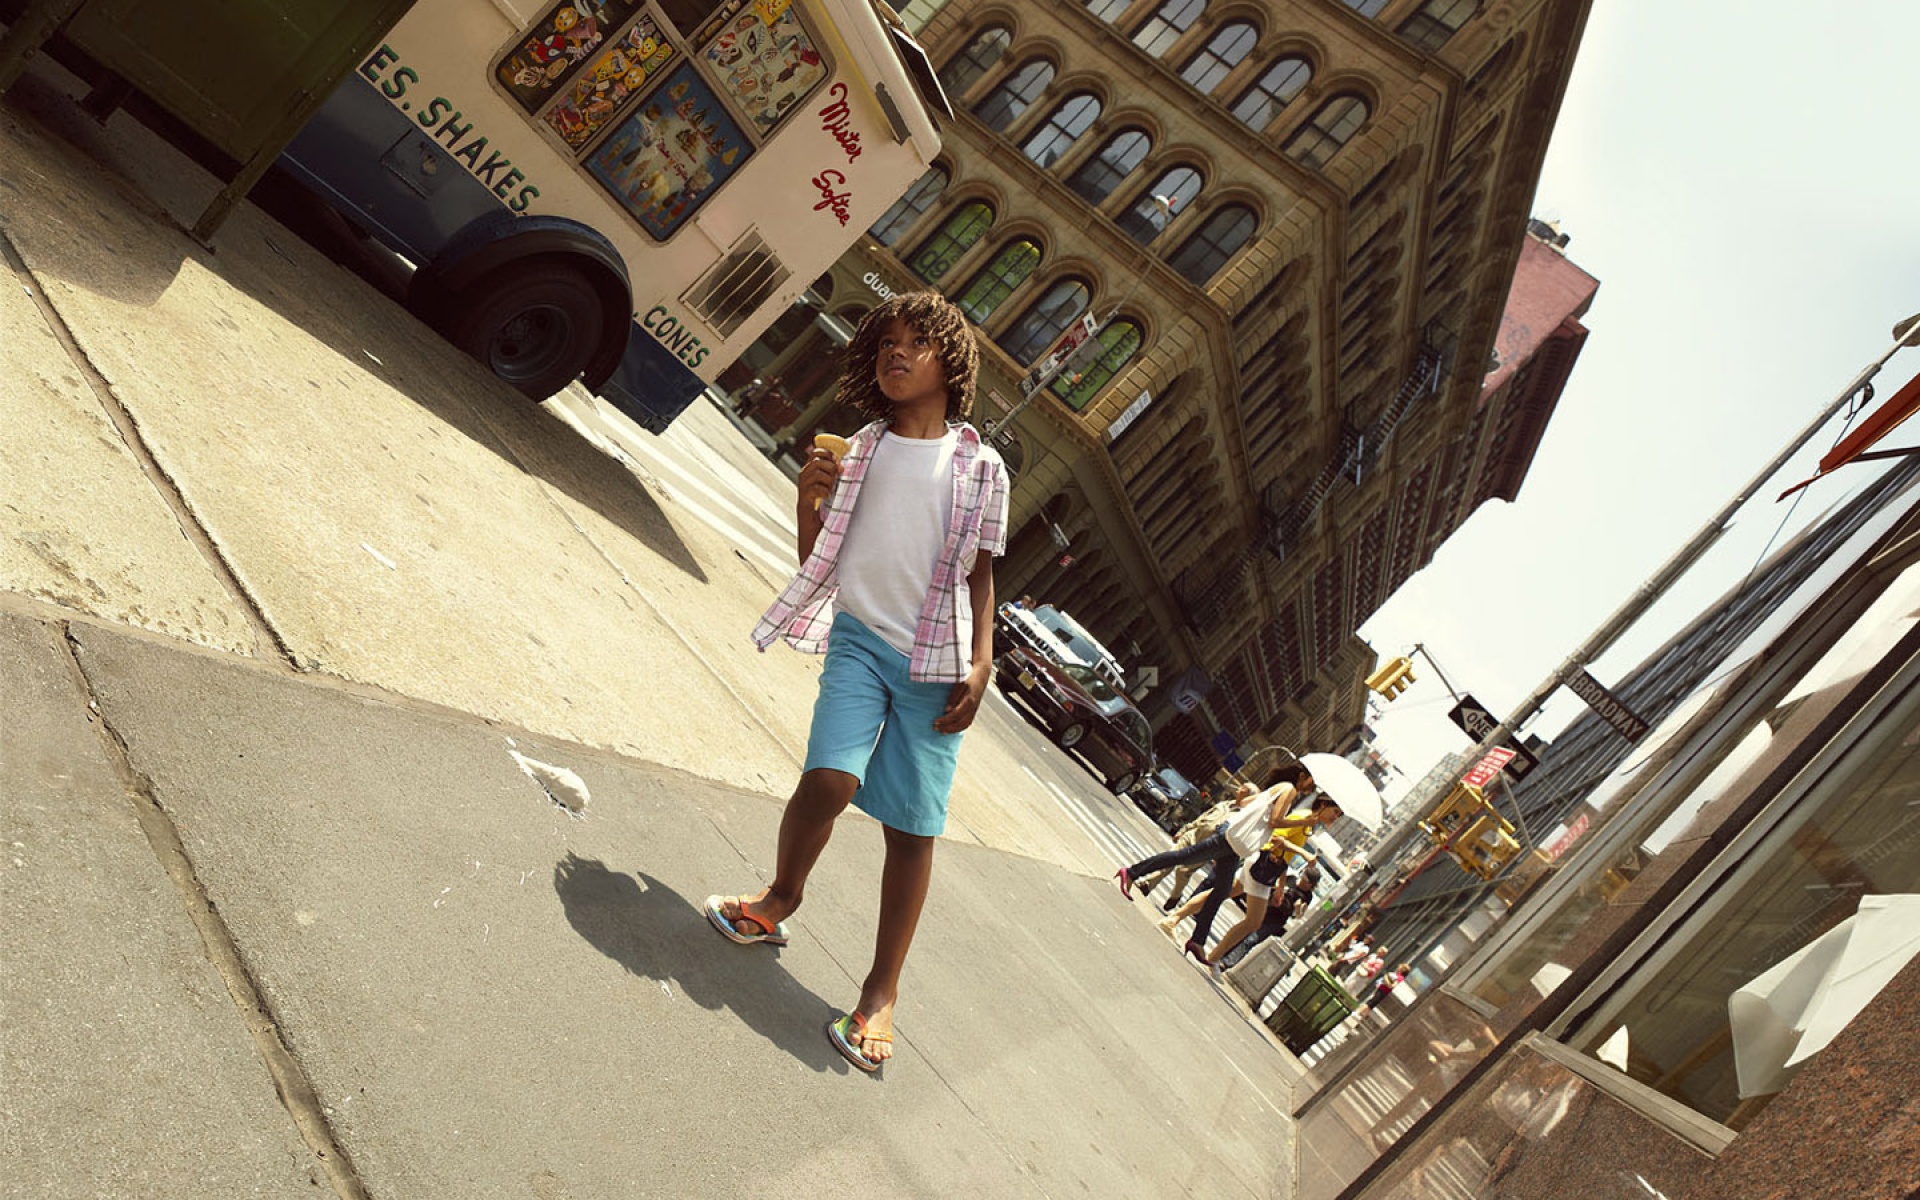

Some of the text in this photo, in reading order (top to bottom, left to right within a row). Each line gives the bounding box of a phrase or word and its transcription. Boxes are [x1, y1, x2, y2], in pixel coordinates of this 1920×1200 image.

[812, 82, 862, 228] Mister Softee
[1467, 712, 1493, 738] ONE
[1573, 674, 1645, 738] BROADWAY
